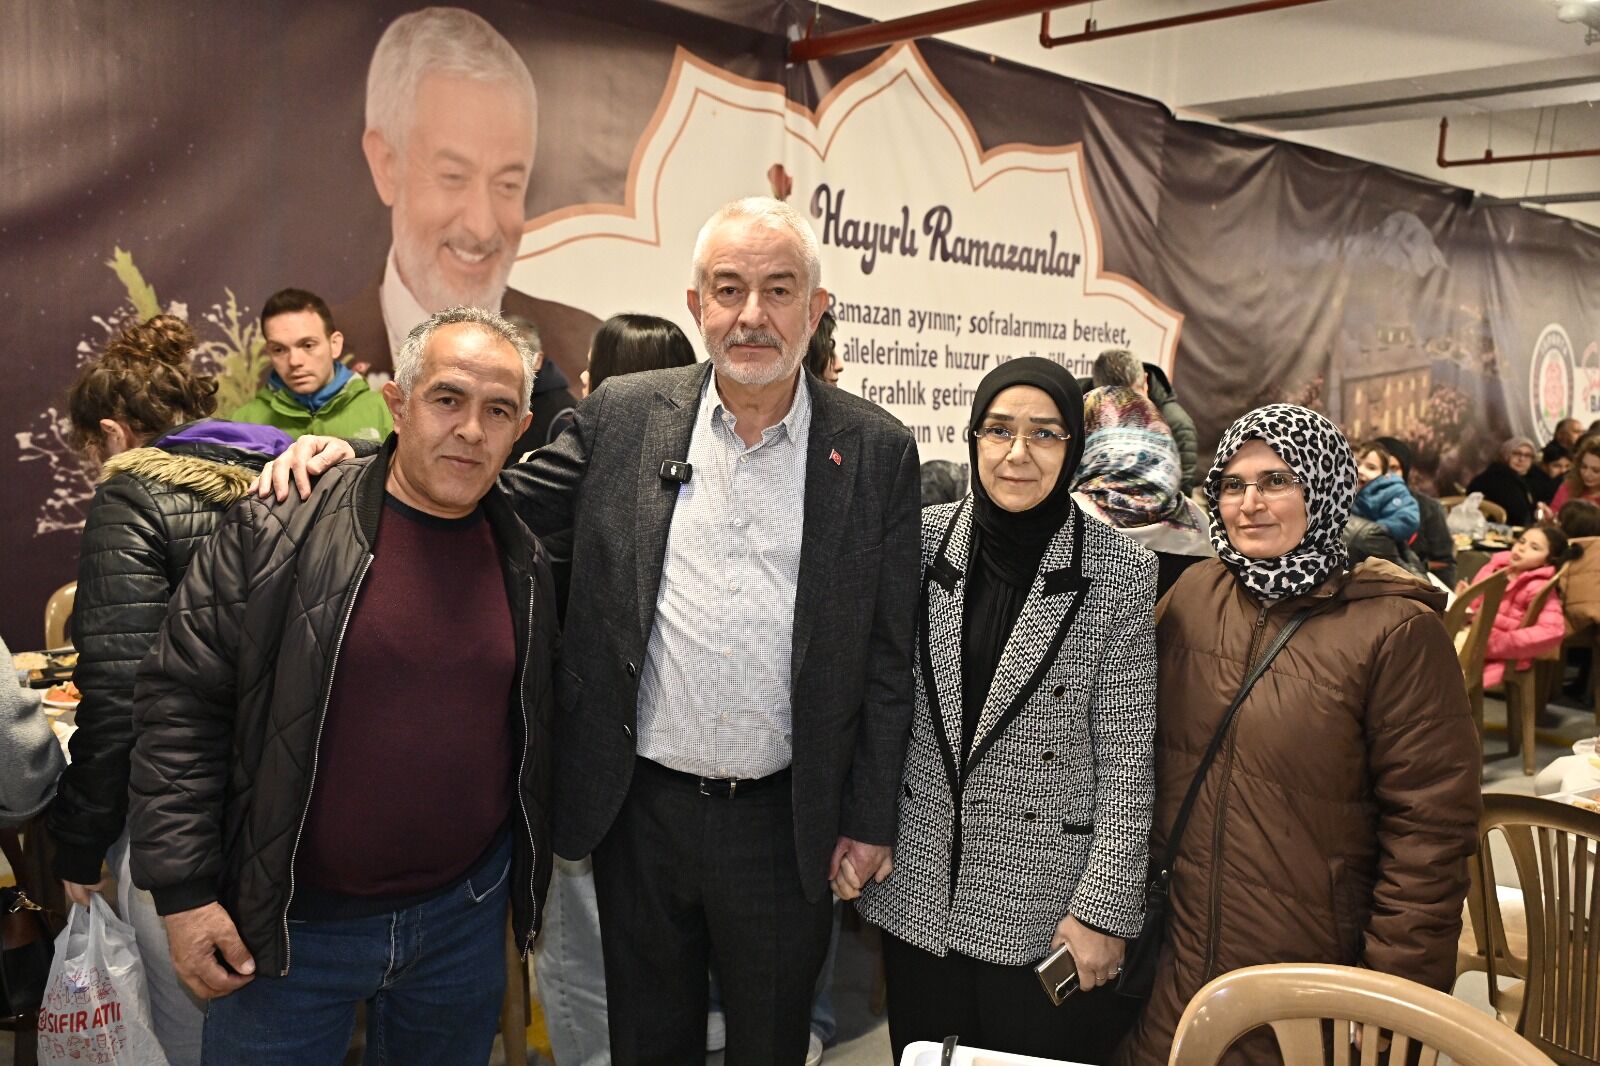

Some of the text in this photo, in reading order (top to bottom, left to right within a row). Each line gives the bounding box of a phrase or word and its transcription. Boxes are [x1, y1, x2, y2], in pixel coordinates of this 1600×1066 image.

[810, 183, 1080, 278] Hayırlı Ramazanlar
[908, 309, 962, 337] ayının;
[969, 310, 1067, 340] sofralarımıza
[1073, 318, 1131, 348] bereket,
[843, 337, 938, 368] ailelerimize
[945, 345, 989, 371] huzur
[861, 377, 926, 405] ferahlık
[937, 425, 955, 443] ve
[47, 1010, 88, 1034] SIFIR
